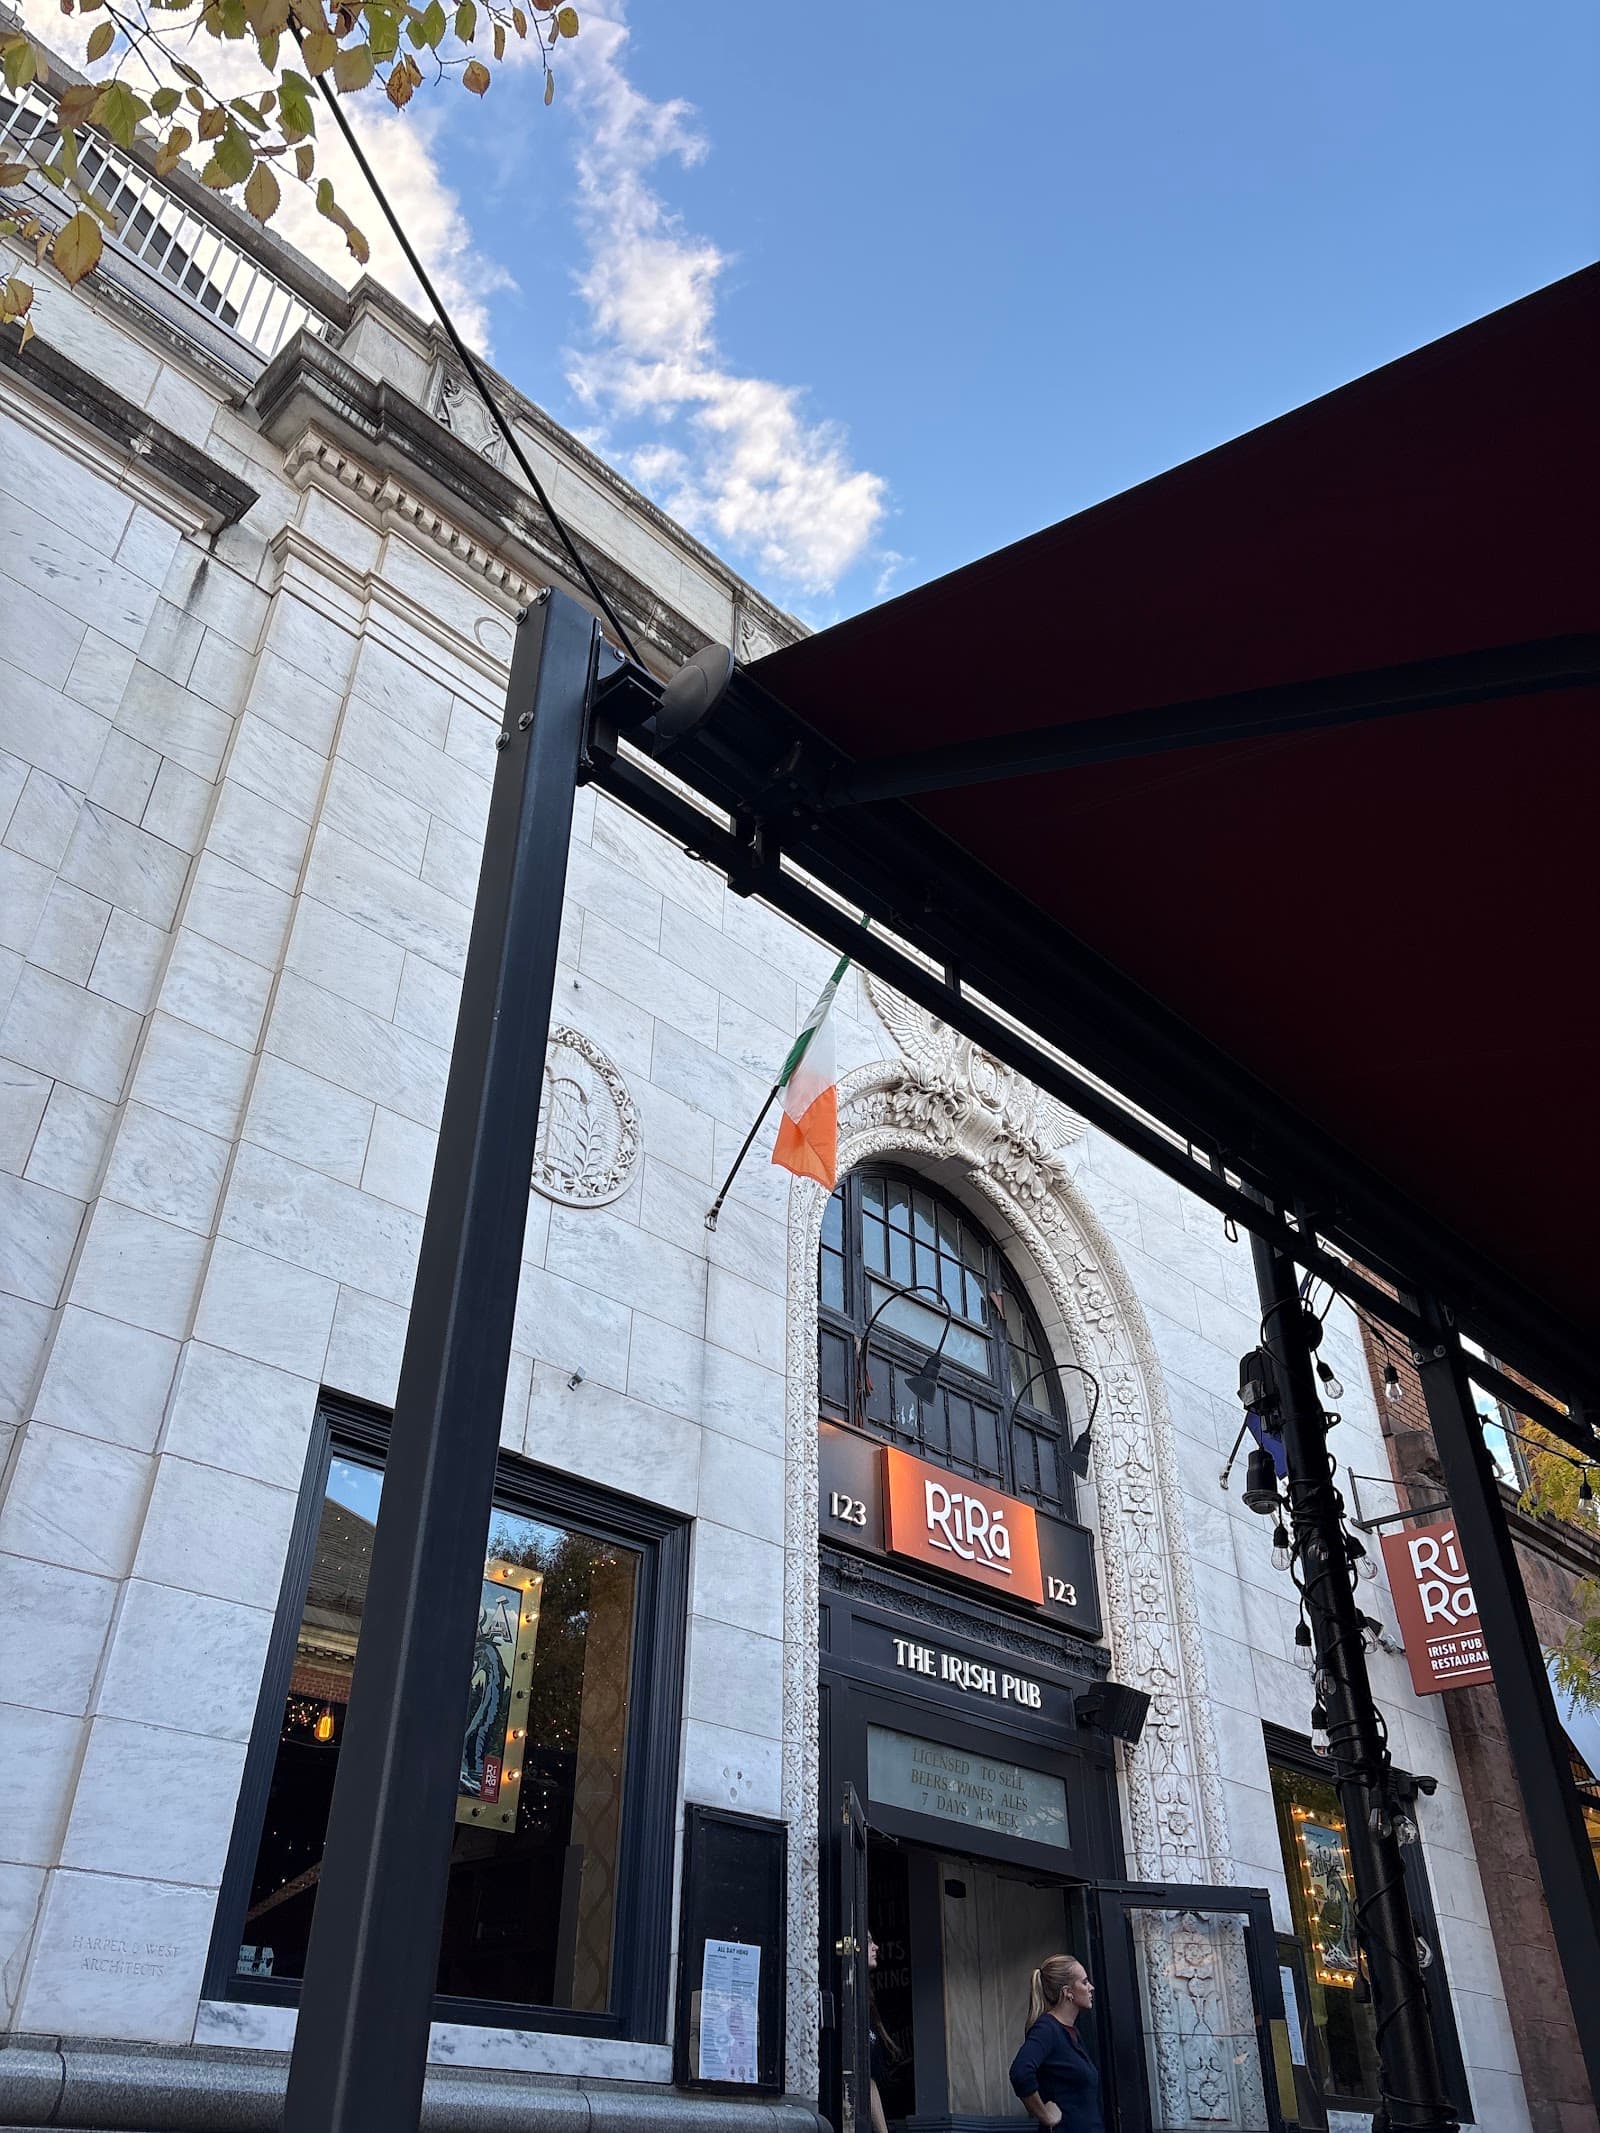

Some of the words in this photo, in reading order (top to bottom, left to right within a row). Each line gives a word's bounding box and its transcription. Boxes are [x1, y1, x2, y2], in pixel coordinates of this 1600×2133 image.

[830, 1492, 867, 1526] 123
[1048, 1576, 1077, 1606] 123
[1428, 1642, 1457, 1658] IRISH
[1461, 1638, 1483, 1651] PUB
[1431, 1651, 1489, 1671] RESTAURAN
[893, 1638, 937, 1676] THE
[941, 1654, 997, 1695] IRISH
[1002, 1673, 1042, 1709] PUB
[912, 1747, 970, 1775] LICENSED
[981, 1766, 996, 1782] TO
[999, 1771, 1024, 1791] SELL
[911, 1769, 948, 1791] BEERS
[957, 1781, 993, 1803] WINES
[1001, 1793, 1028, 1811] ALES
[922, 1792, 929, 1805] 7
[936, 1795, 967, 1816] DAYS
[976, 1806, 983, 1821] A
[987, 1809, 1019, 1829] WEEK
[72, 1935, 127, 1953] HARPER
[145, 1943, 181, 1958] WEST
[81, 1957, 165, 1976] ARCHITECTS
